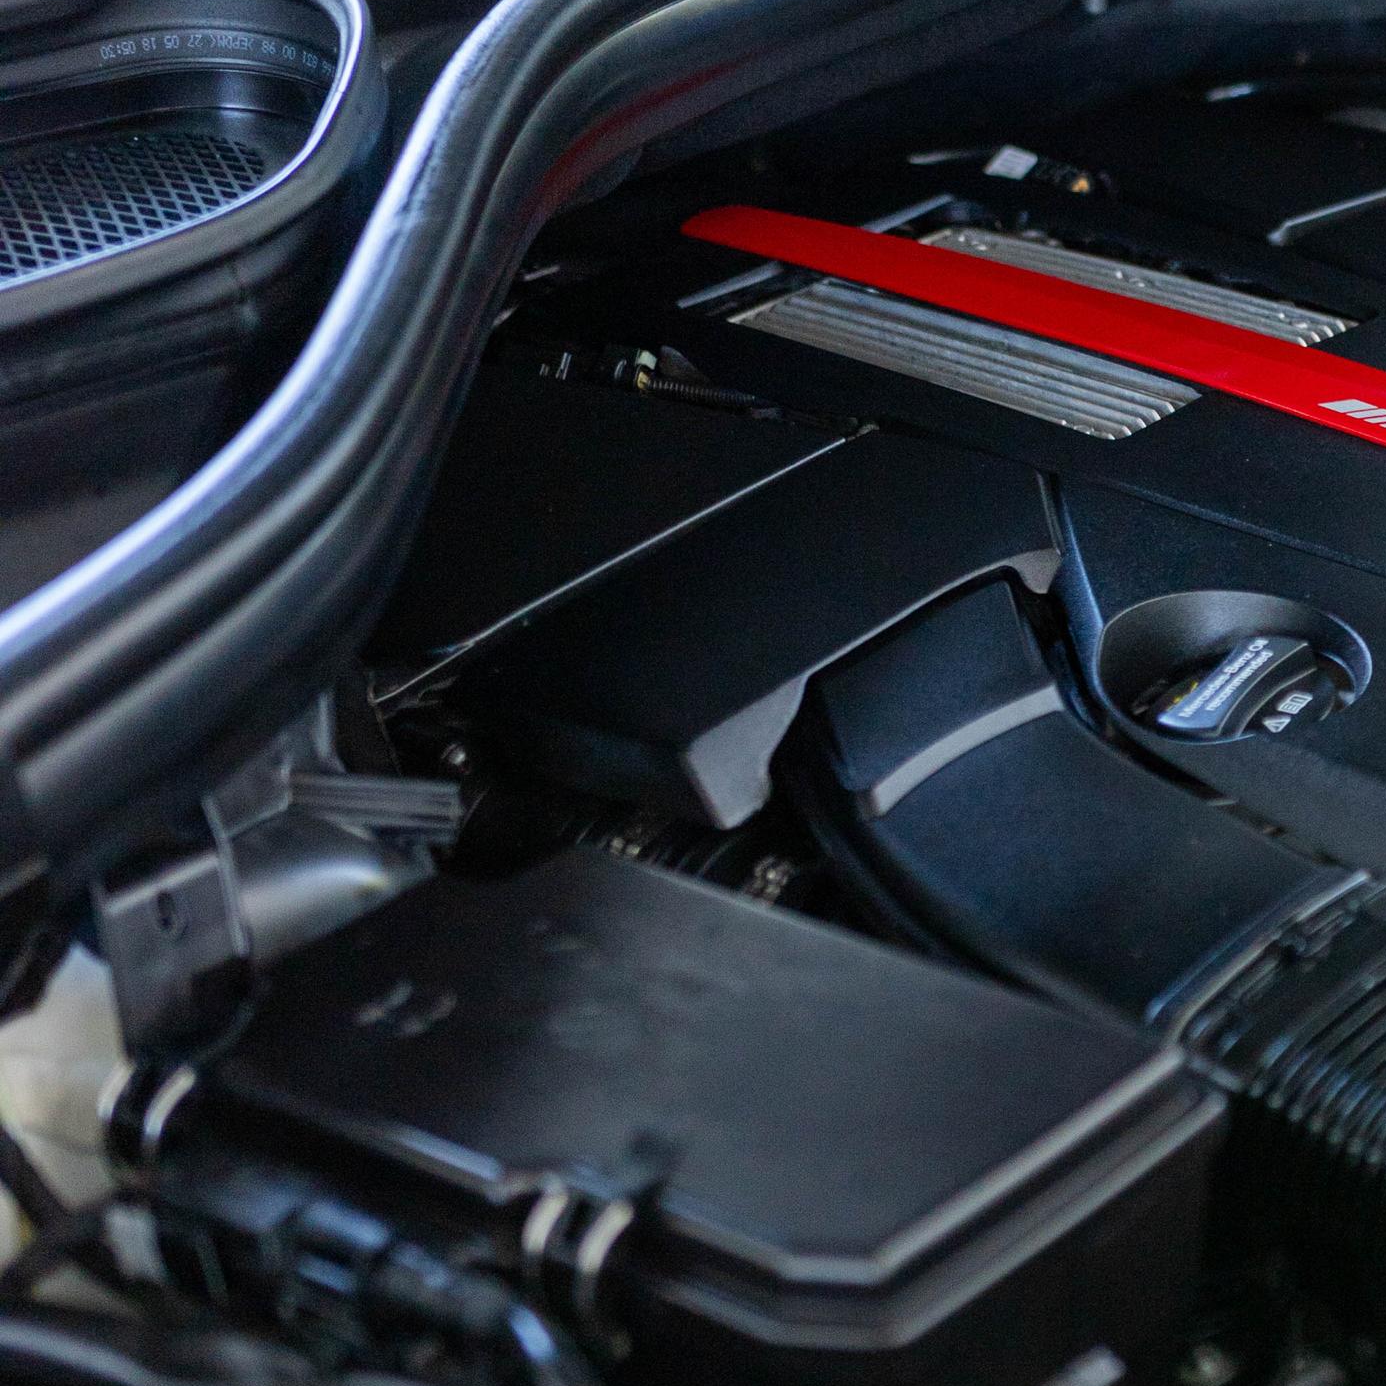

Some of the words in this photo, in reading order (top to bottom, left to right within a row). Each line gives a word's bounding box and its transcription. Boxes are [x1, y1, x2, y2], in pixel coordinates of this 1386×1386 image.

[187, 34, 204, 48] 27
[1178, 651, 1257, 718] Mercedes-Benz
[1204, 649, 1274, 711] recommended
